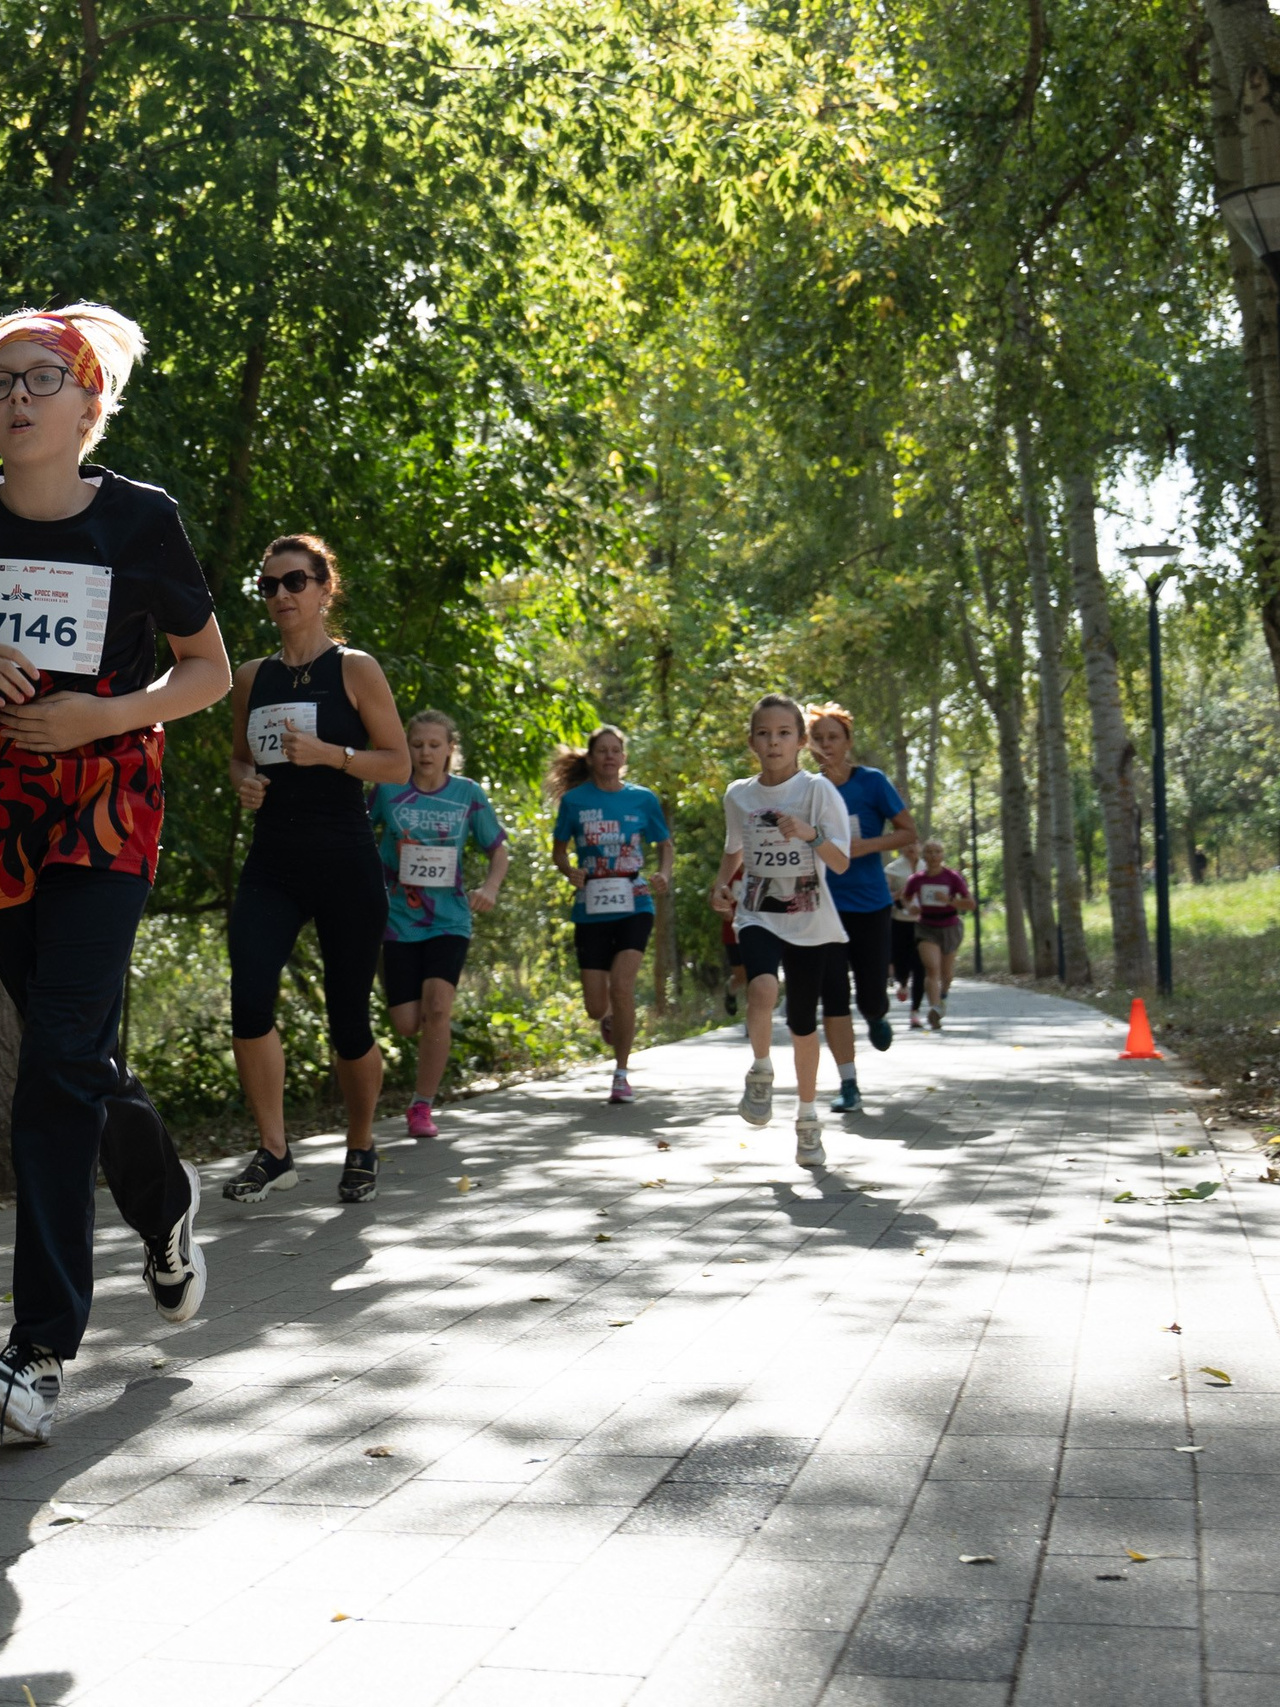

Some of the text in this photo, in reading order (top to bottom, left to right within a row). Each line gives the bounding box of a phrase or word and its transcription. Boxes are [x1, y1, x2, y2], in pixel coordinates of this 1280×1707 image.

[753, 851, 800, 867] 7298
[409, 864, 446, 878] 7287
[594, 895, 626, 906] 7243
